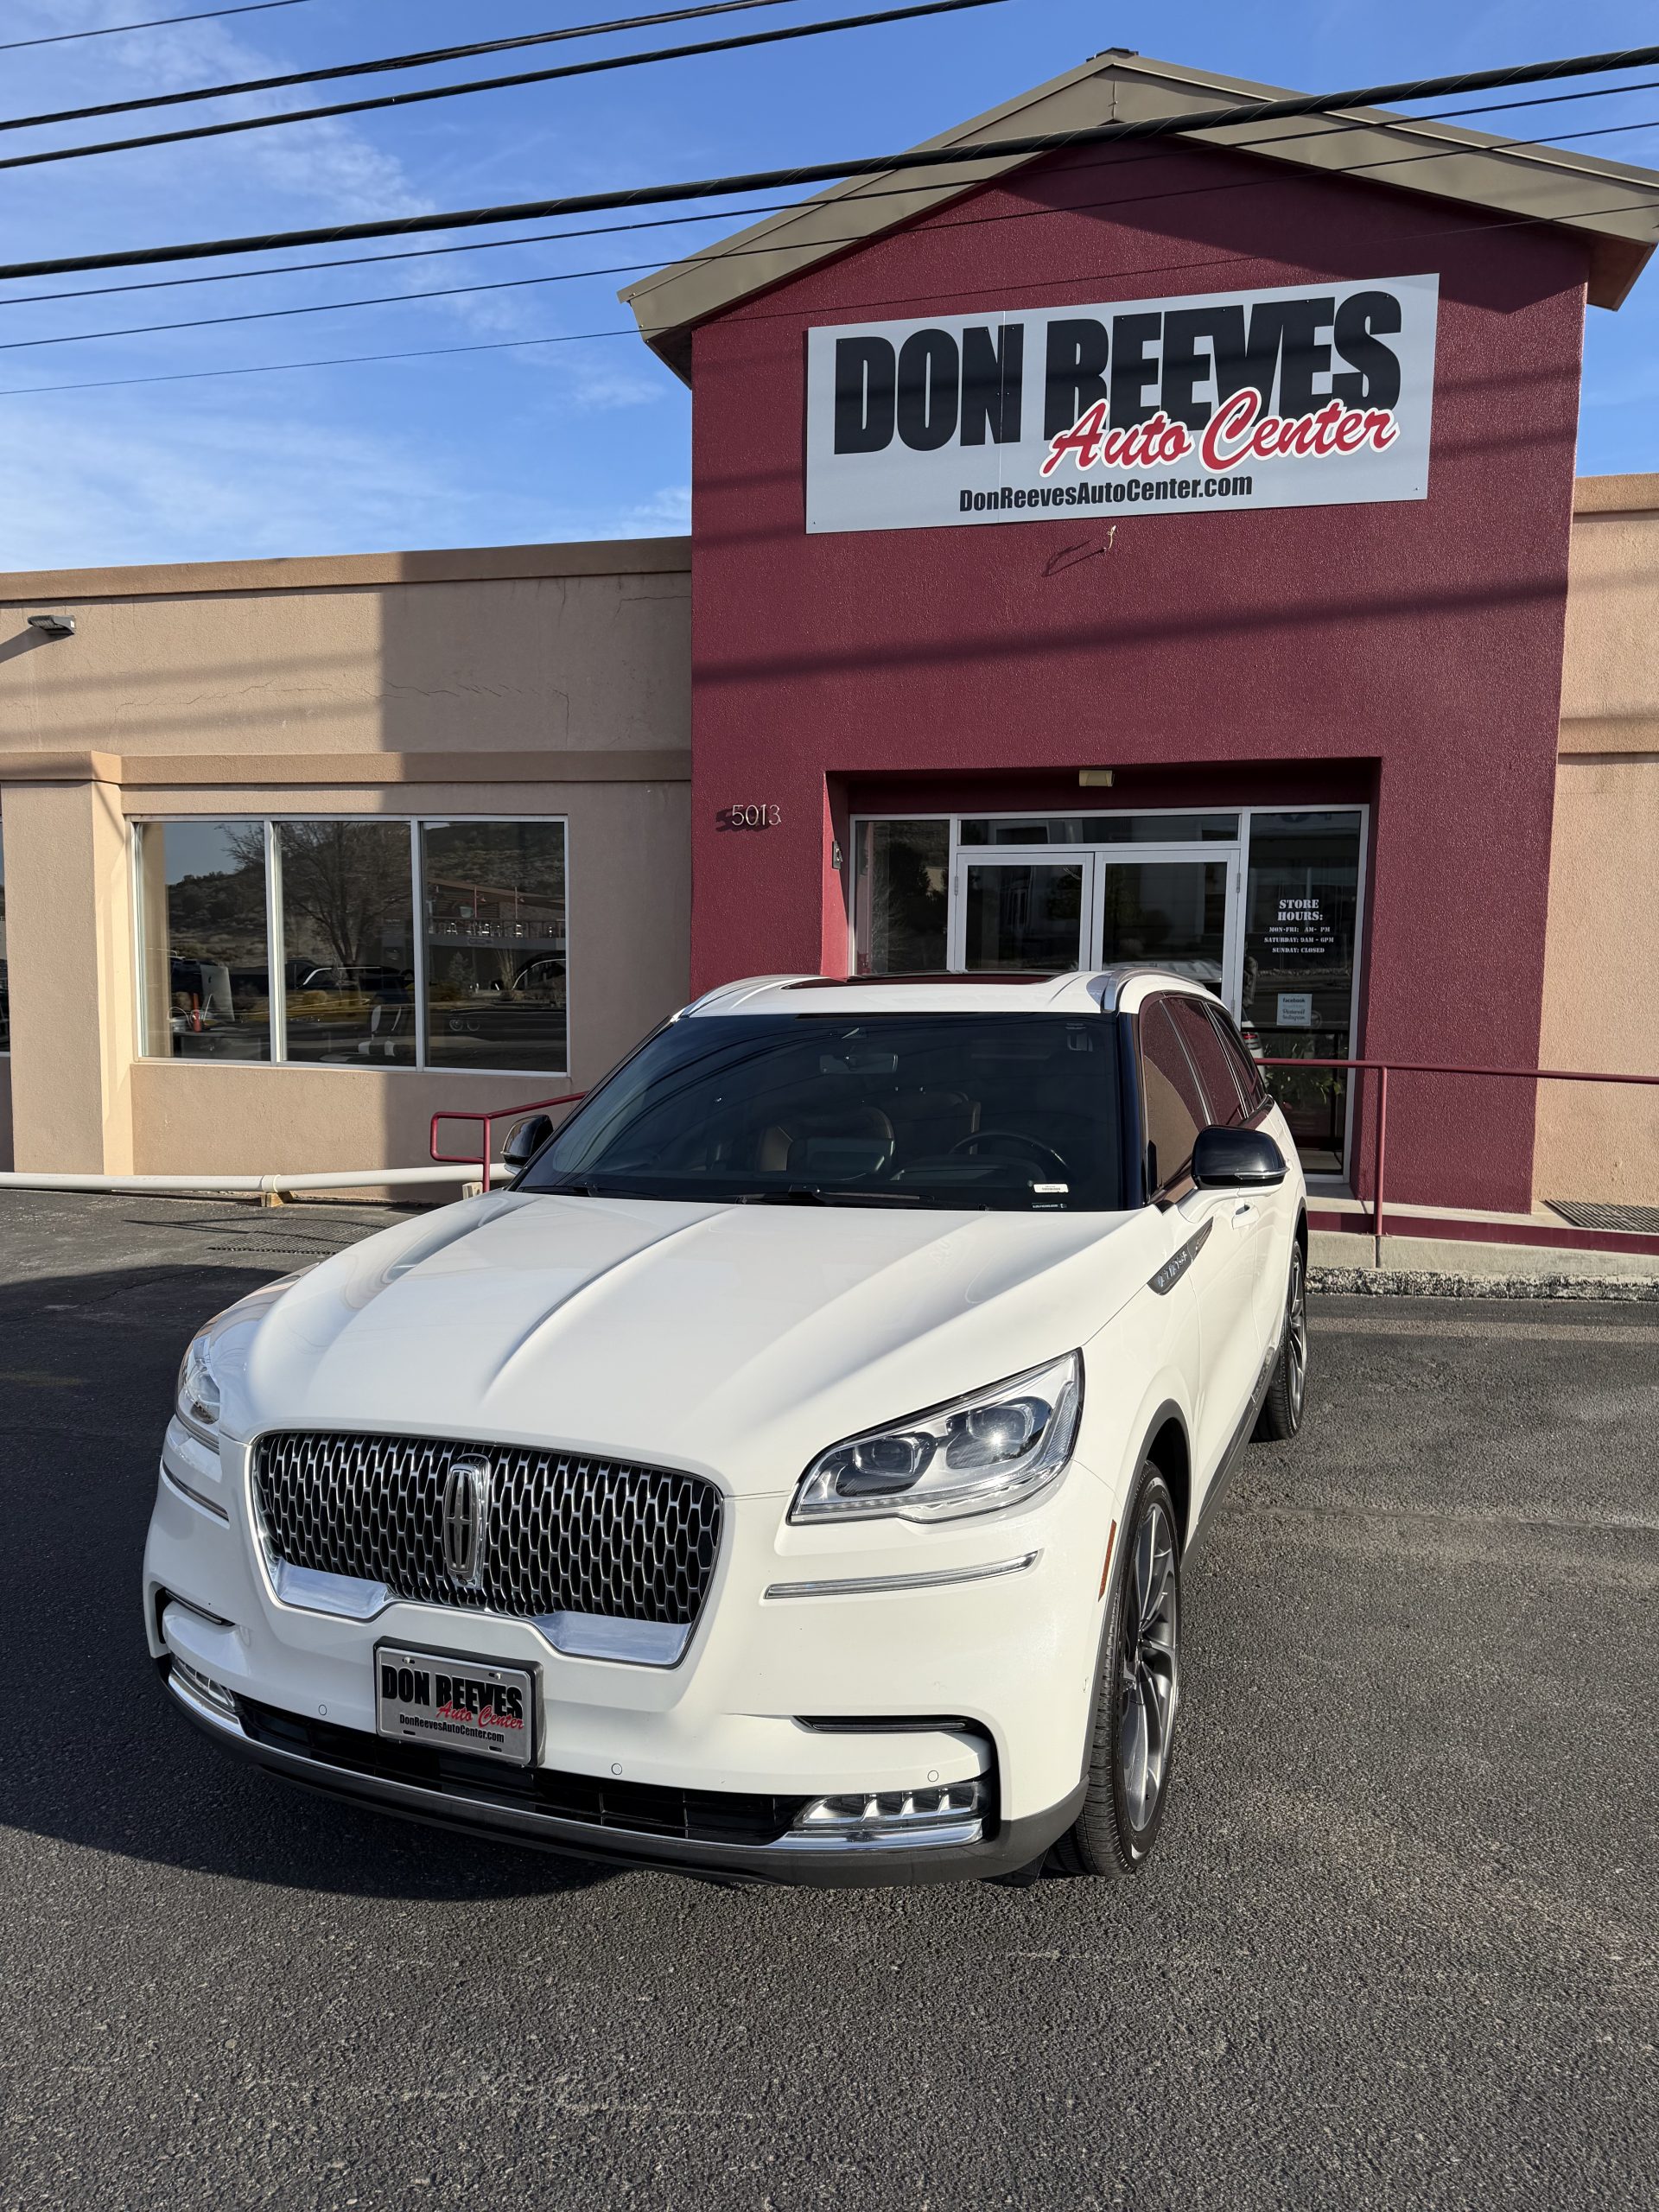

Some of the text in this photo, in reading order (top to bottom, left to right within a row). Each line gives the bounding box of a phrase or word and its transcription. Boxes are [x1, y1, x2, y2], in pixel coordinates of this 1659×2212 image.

[834, 290, 1402, 454] DON REEVES
[1040, 387, 1401, 477] Auto Center
[959, 475, 1253, 512] DonReevesAutoCenter.com
[731, 804, 781, 826] 5013
[1277, 911, 1324, 921] HOURS:
[1279, 899, 1319, 909] STORE
[381, 1665, 524, 1722] DON REEVES
[399, 1713, 505, 1744] DonReevesAutoCenter.com
[435, 1700, 524, 1730] Auto Center
